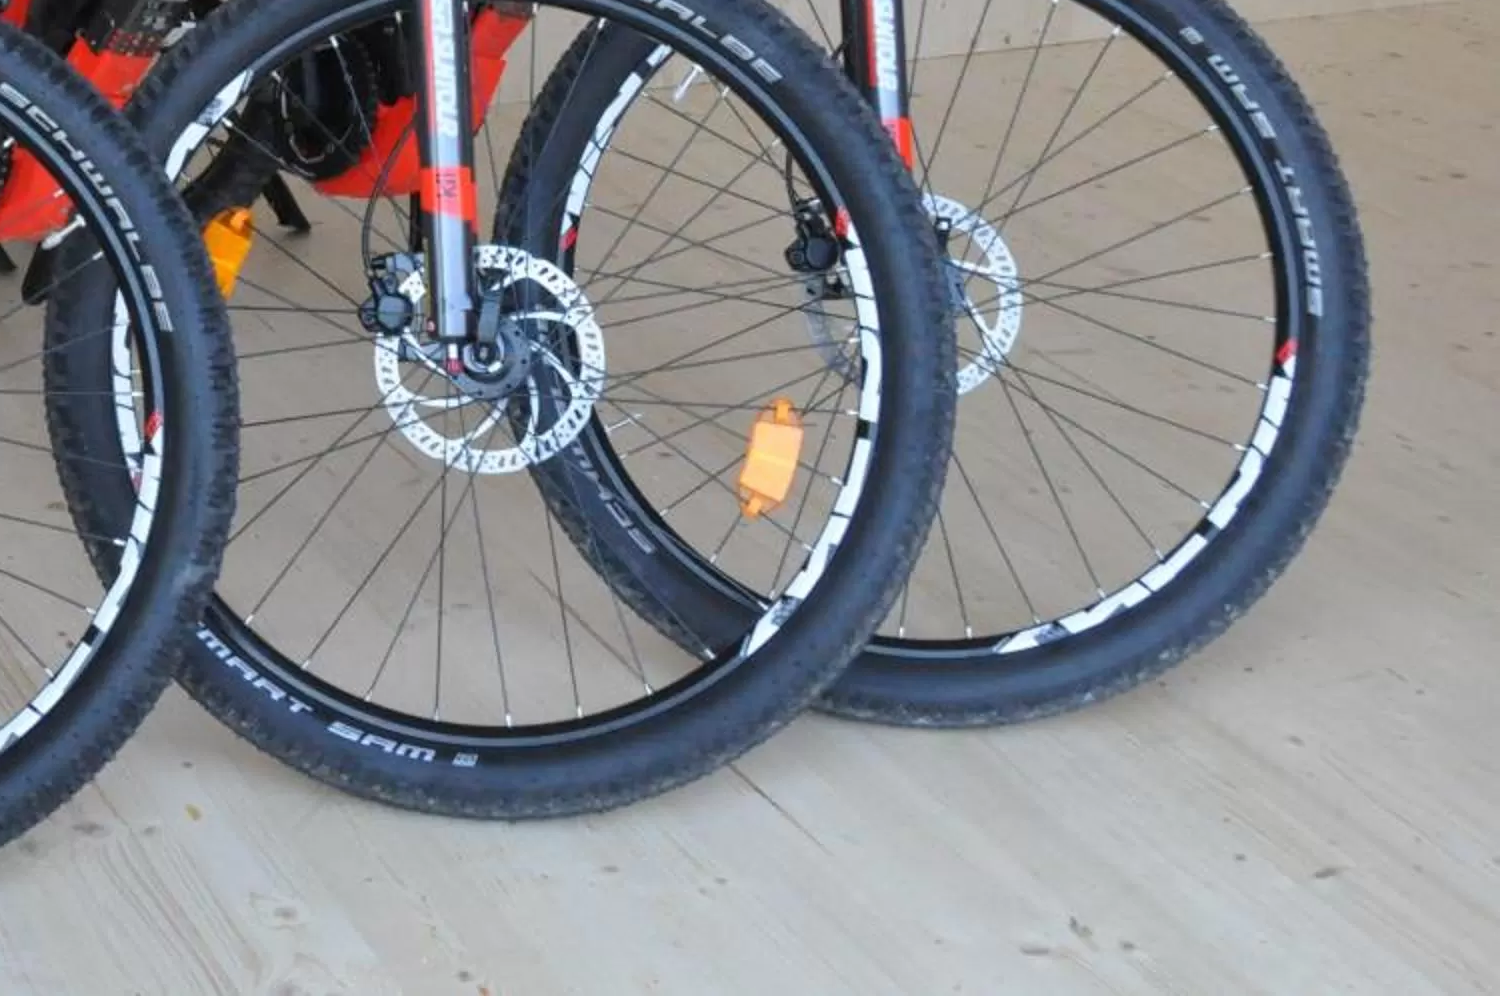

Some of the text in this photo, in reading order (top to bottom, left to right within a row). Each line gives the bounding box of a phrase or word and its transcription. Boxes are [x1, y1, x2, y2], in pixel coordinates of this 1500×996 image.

[1207, 54, 1324, 317] SMART SAM
[196, 621, 437, 763] MART SAM
